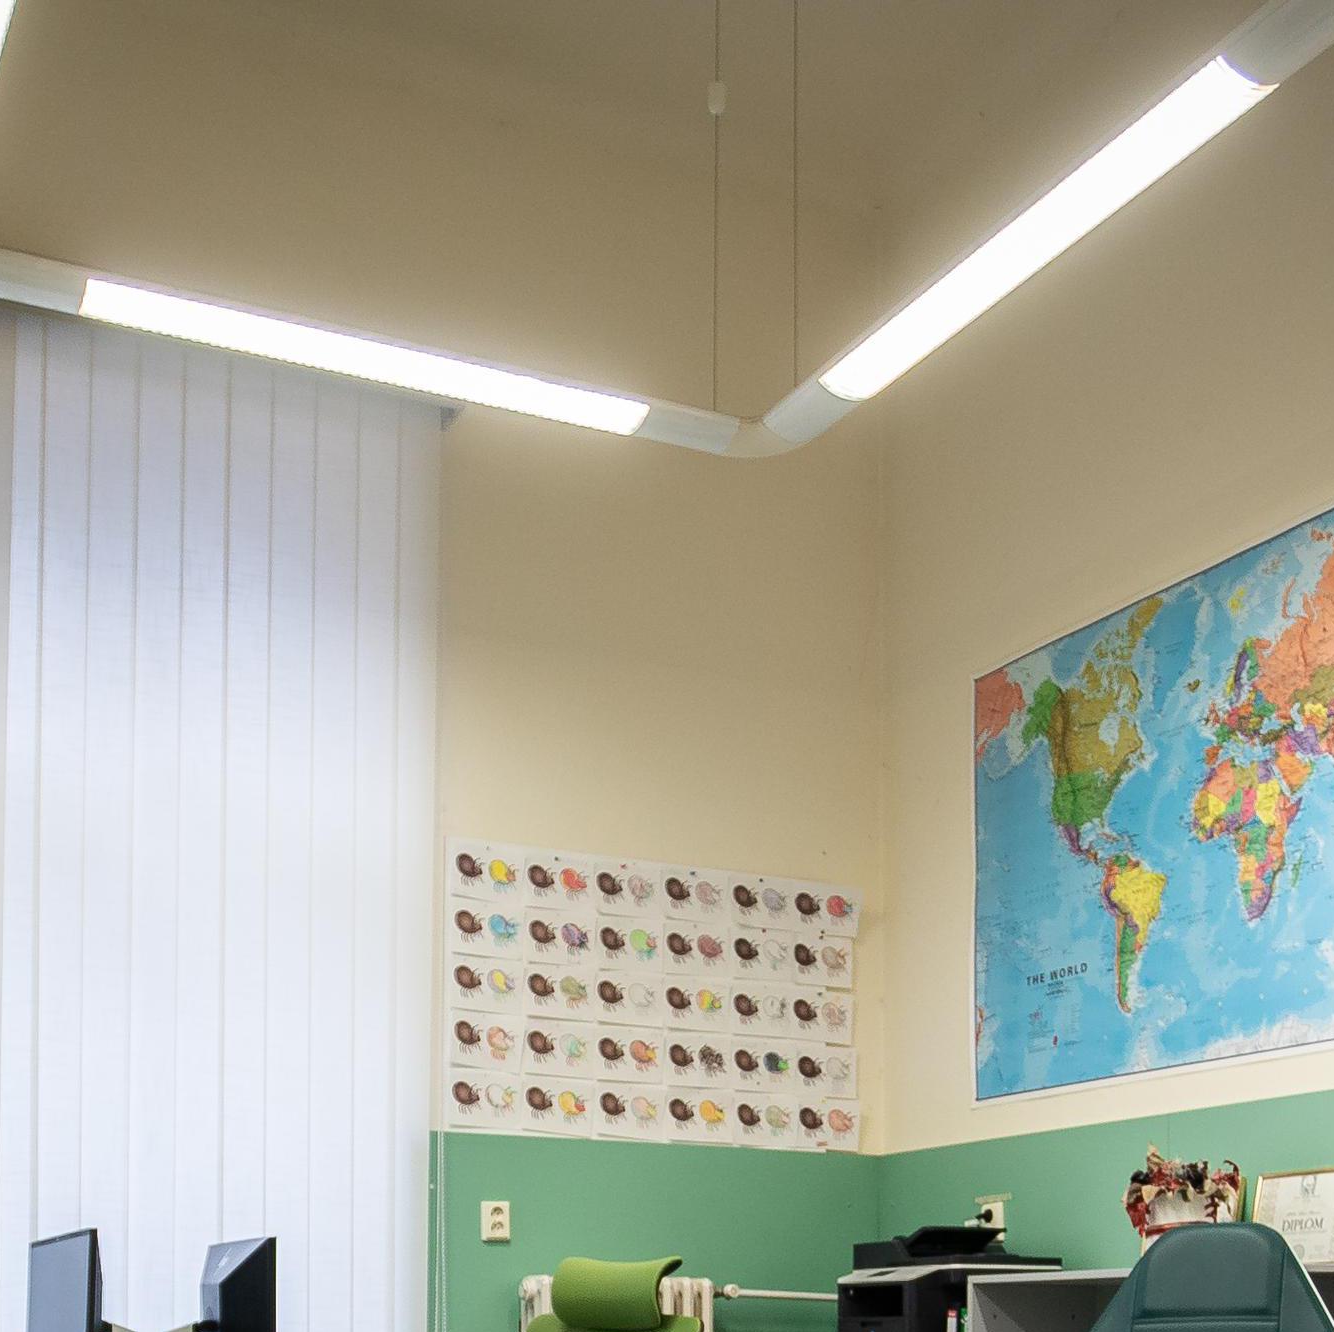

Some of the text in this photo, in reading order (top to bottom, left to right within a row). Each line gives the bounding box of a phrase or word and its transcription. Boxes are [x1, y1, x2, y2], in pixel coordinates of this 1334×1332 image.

[1027, 962, 1088, 986] THE WORLD
[1281, 1217, 1324, 1232] DIPLOM
